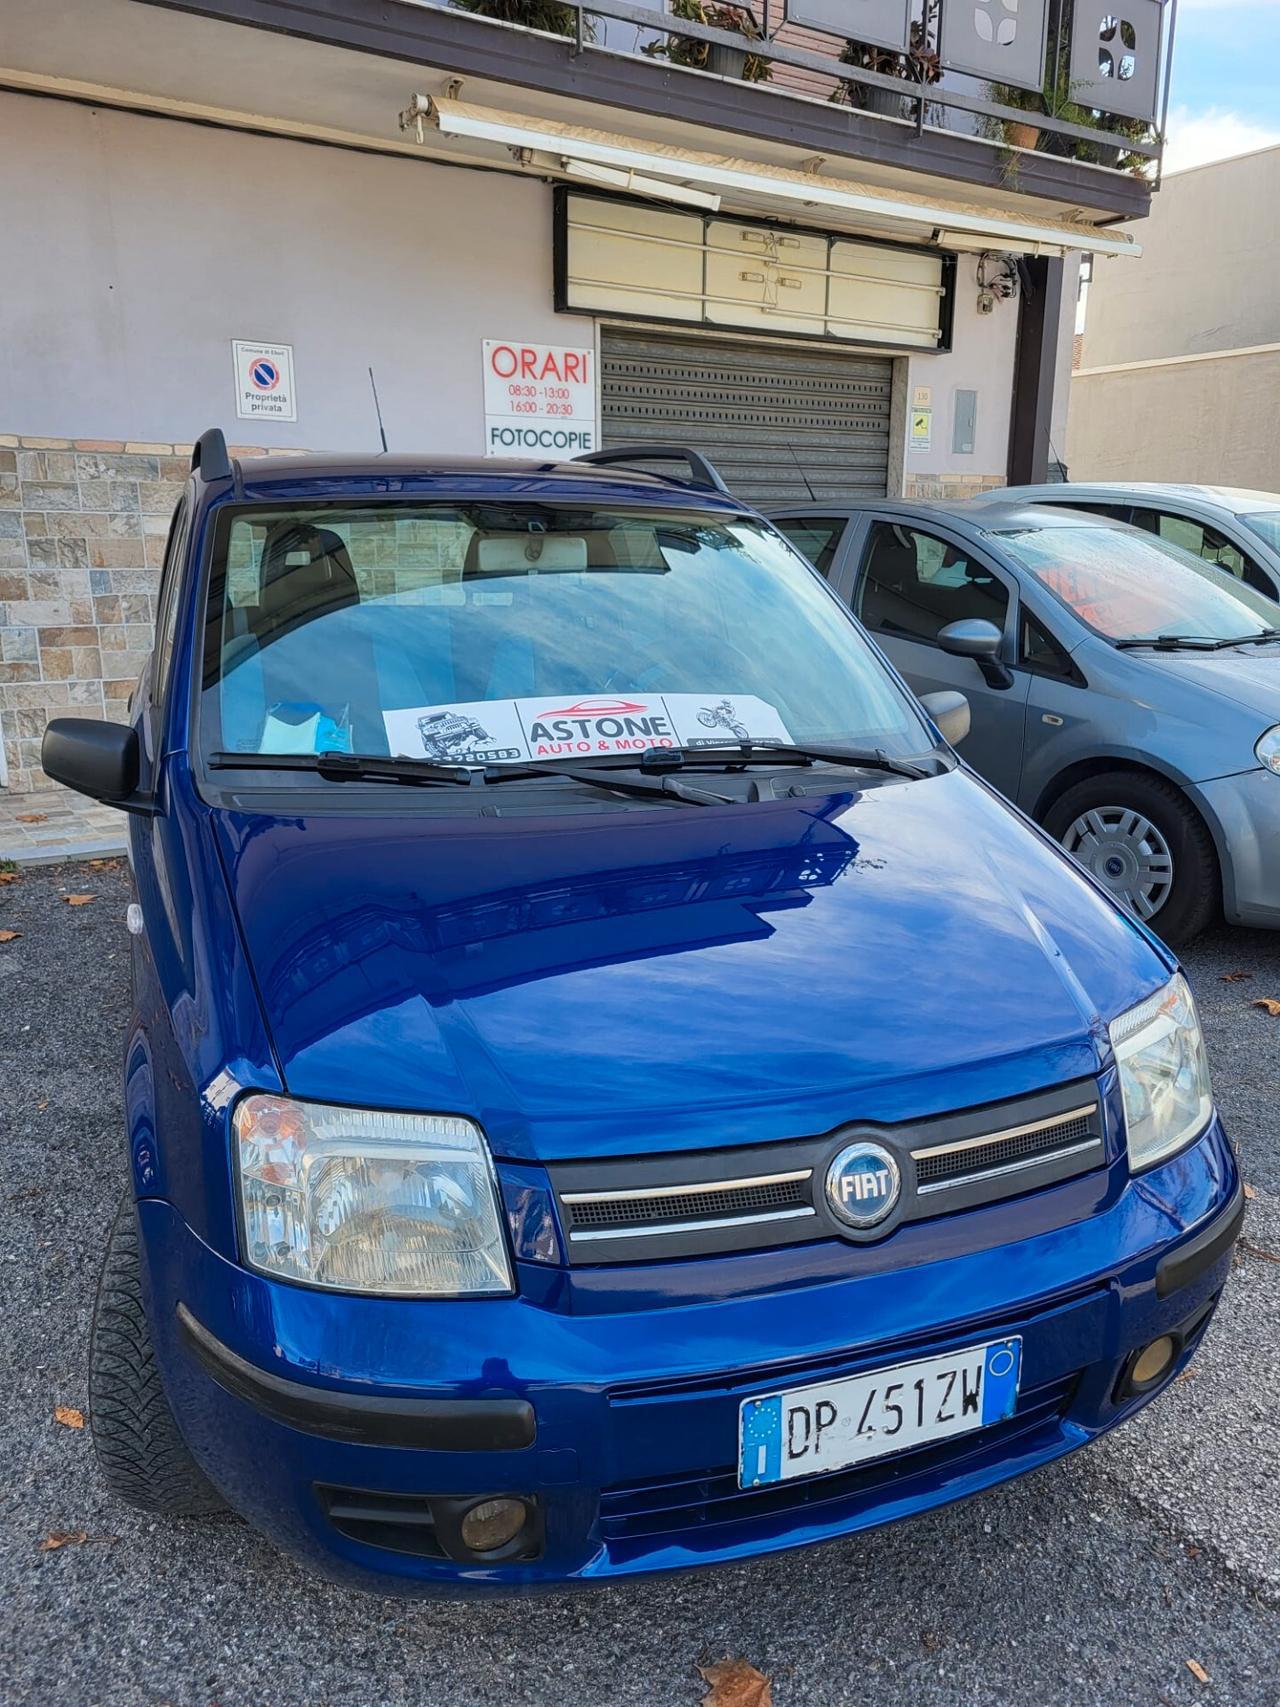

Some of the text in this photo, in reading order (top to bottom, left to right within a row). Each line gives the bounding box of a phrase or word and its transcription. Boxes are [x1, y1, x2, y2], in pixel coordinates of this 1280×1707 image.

[492, 346, 587, 384] ORARI
[245, 391, 287, 404] Proprietà
[508, 384, 537, 398] 08:30
[251, 403, 282, 413] privata
[510, 401, 537, 413] 16:00
[546, 403, 573, 416] 20:30
[491, 427, 592, 450] FOTOCOPIE
[530, 716, 672, 743] ASTONE
[537, 737, 673, 756] AUTO & MOTO
[841, 1169, 889, 1202] FIAT
[787, 1400, 838, 1460] DP
